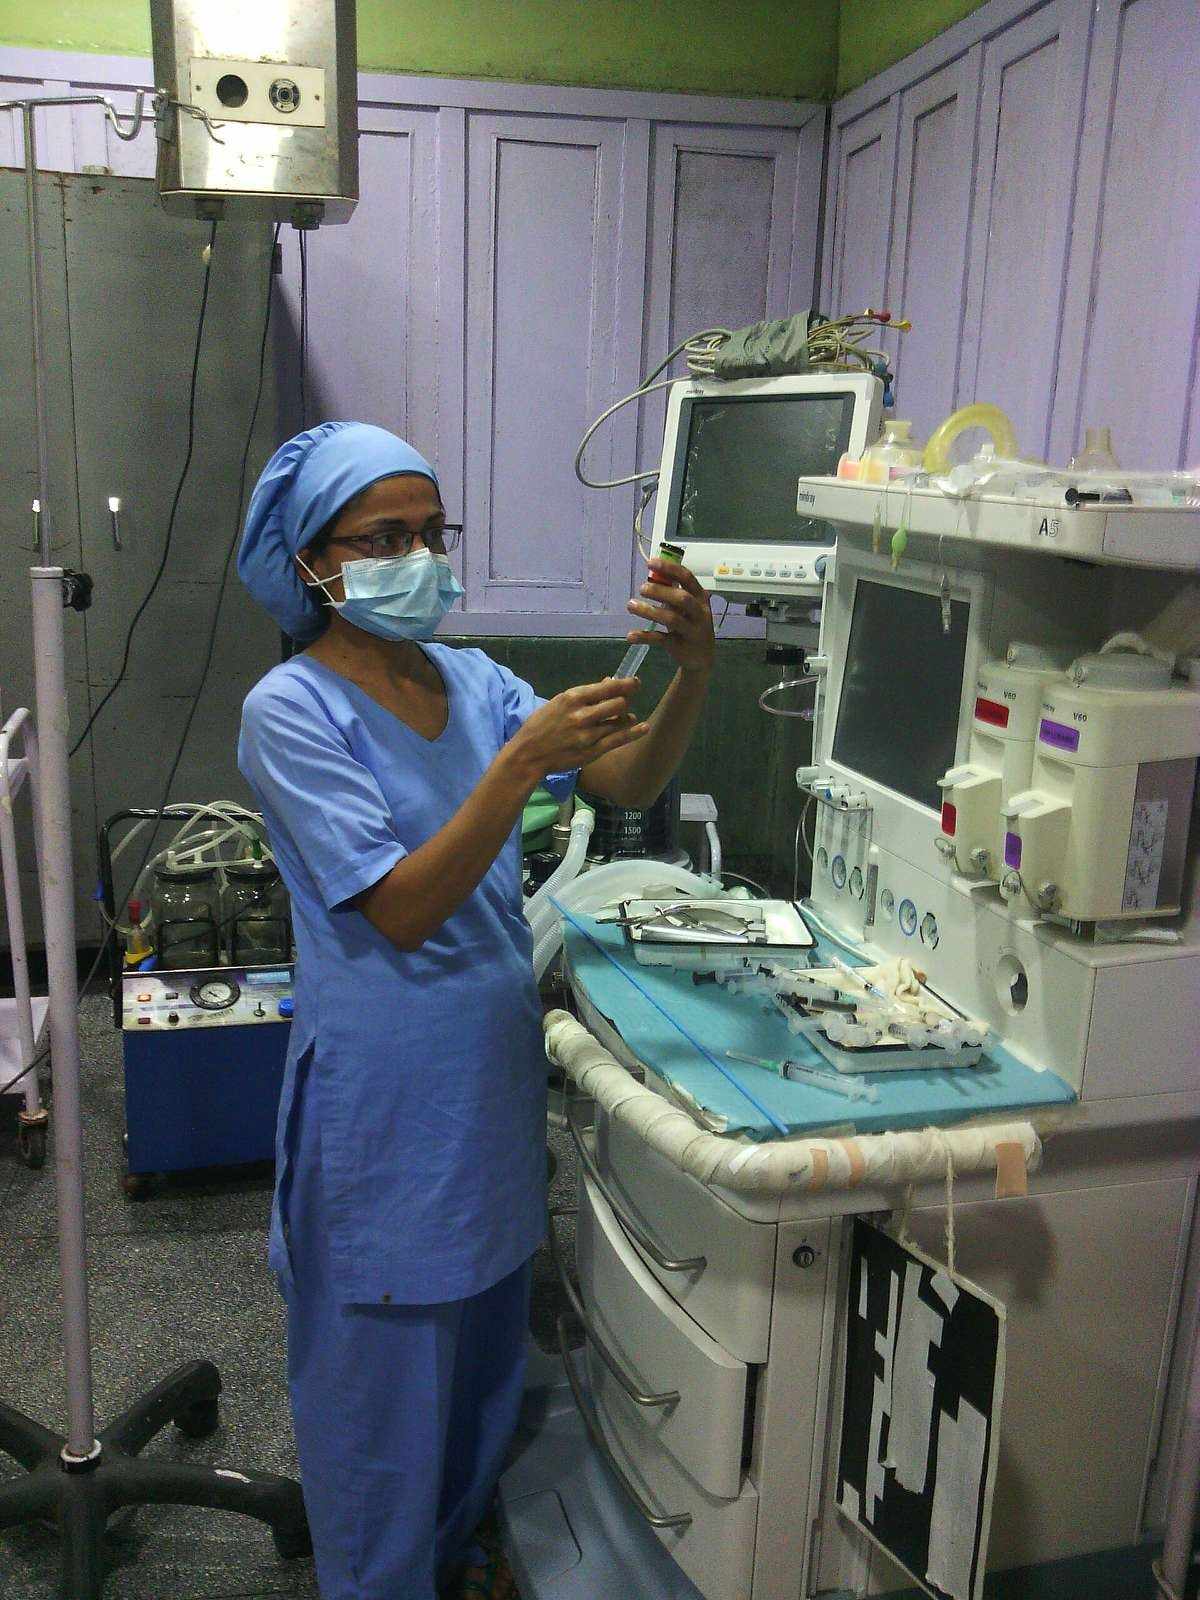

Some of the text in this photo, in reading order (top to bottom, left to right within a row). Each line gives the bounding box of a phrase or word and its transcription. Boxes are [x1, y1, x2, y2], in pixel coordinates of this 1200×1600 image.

[1039, 518, 1061, 538] A5
[1073, 711, 1088, 722] V60
[624, 811, 642, 820] 1200
[623, 826, 642, 835] 1500
